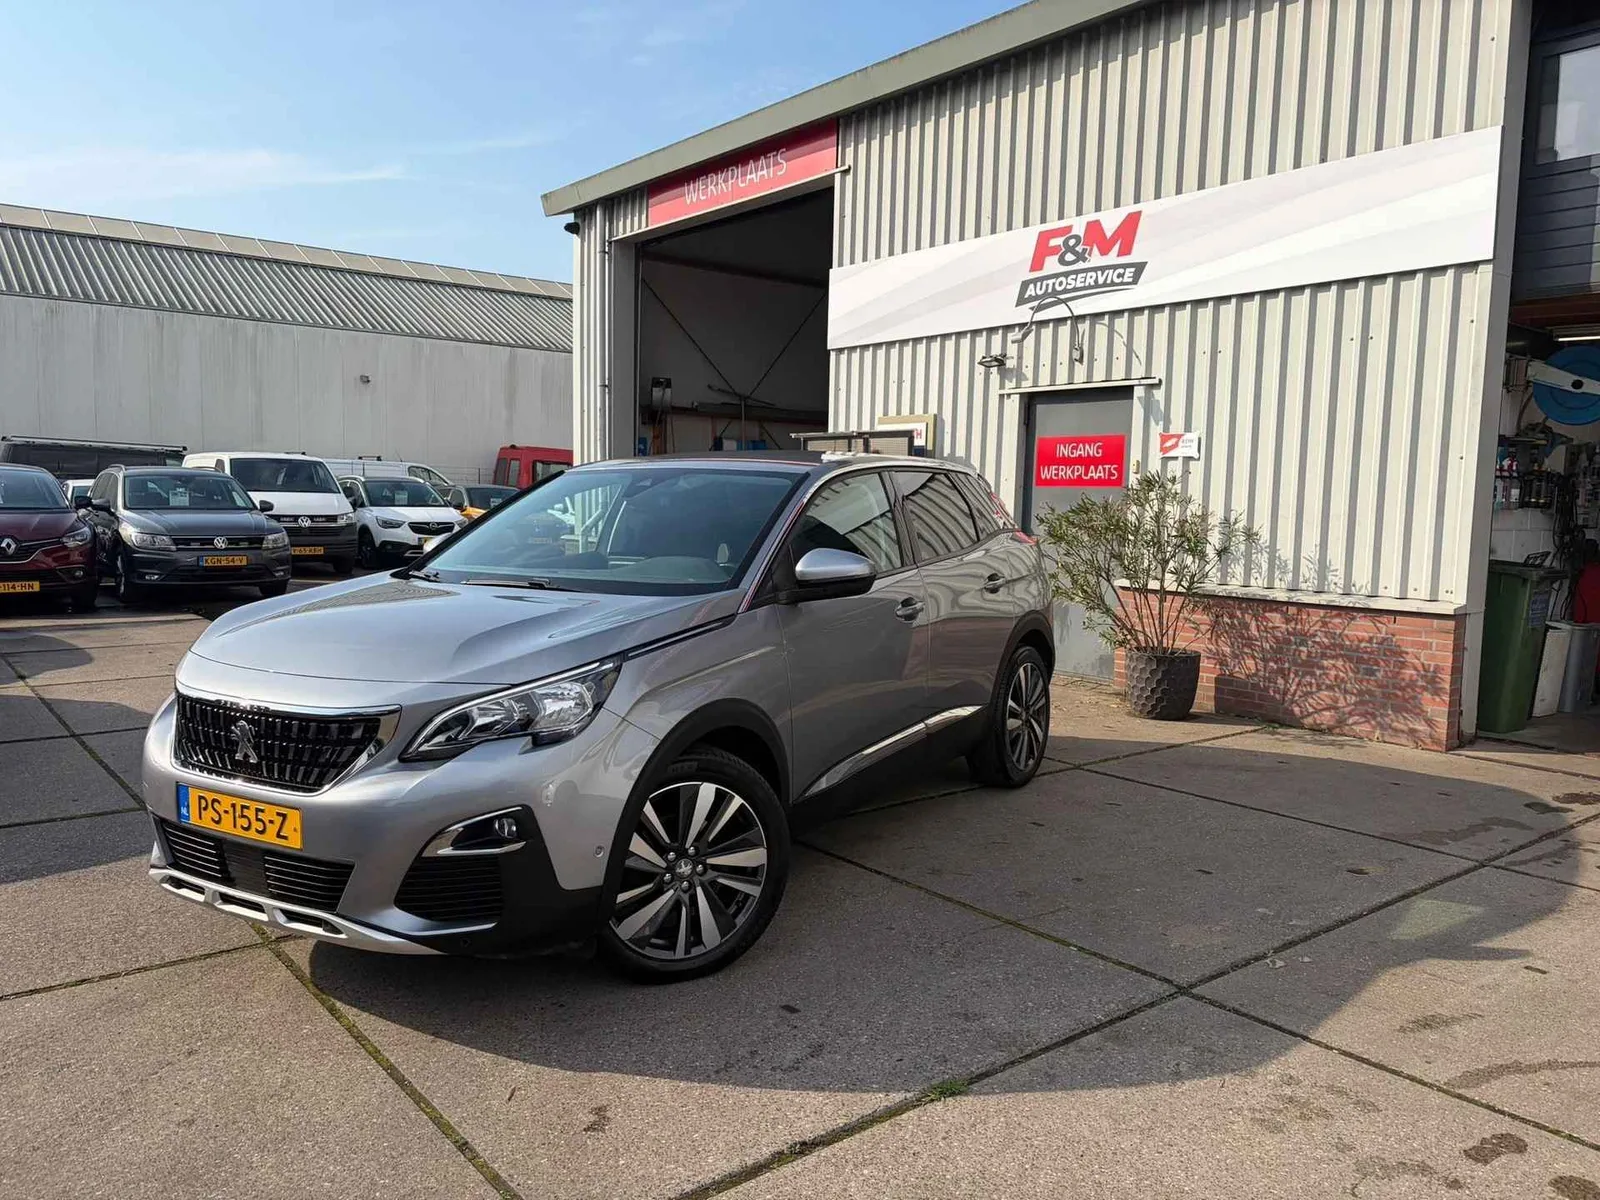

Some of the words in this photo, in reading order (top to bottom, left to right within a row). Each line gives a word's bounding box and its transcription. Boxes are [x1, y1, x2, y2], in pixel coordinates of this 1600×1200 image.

[684, 148, 788, 205] WERKPLAATS
[1029, 210, 1142, 272] F&M
[1024, 267, 1136, 299] AUTOSERVICE
[1056, 442, 1103, 458] INGANG
[1040, 464, 1118, 480] WERKPLAATS
[198, 794, 288, 841] PS-155-Z
